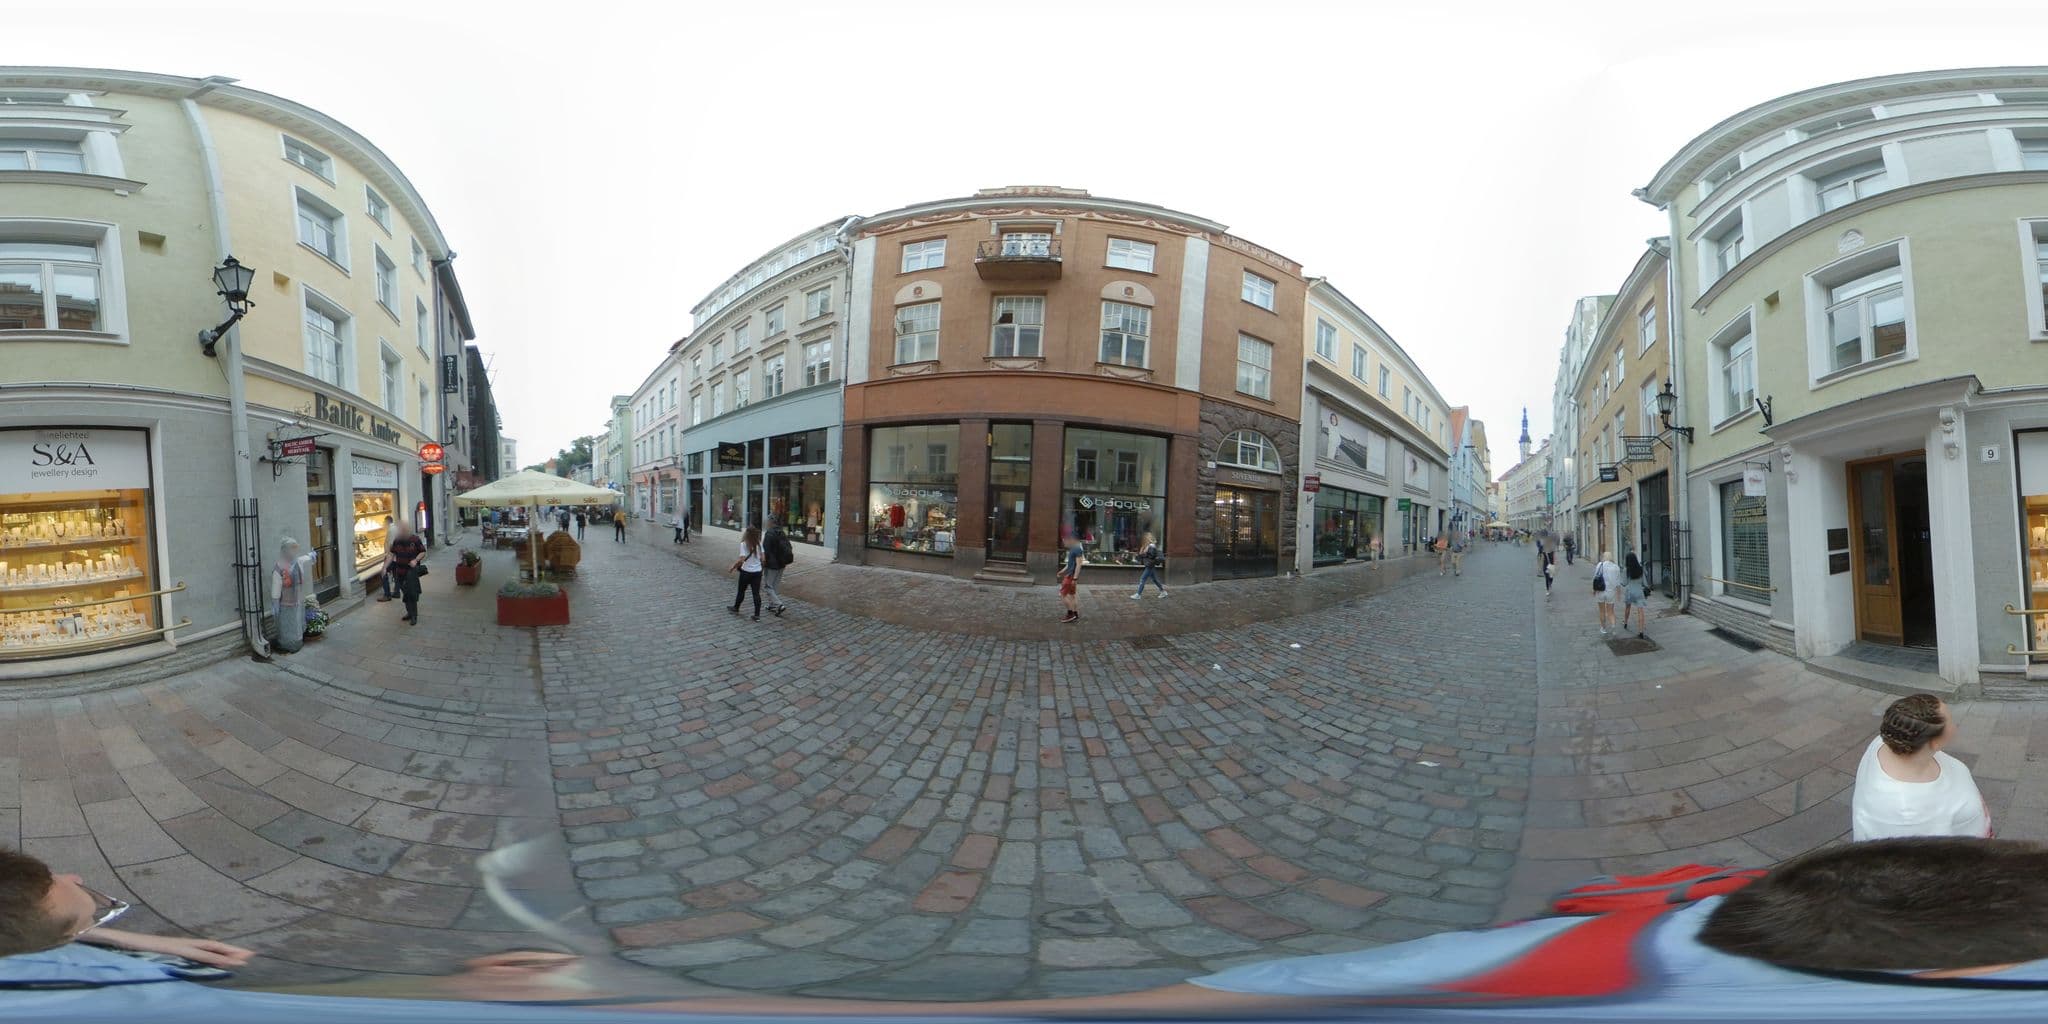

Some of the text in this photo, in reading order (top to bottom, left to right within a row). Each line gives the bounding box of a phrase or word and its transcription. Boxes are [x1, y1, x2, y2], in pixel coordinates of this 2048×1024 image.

[315, 392, 401, 446] Baltic Amber
[32, 442, 95, 466] S&A
[1629, 446, 1651, 454] ANTIQUE
[1988, 449, 1994, 459] 9
[31, 467, 98, 479] jewellery design
